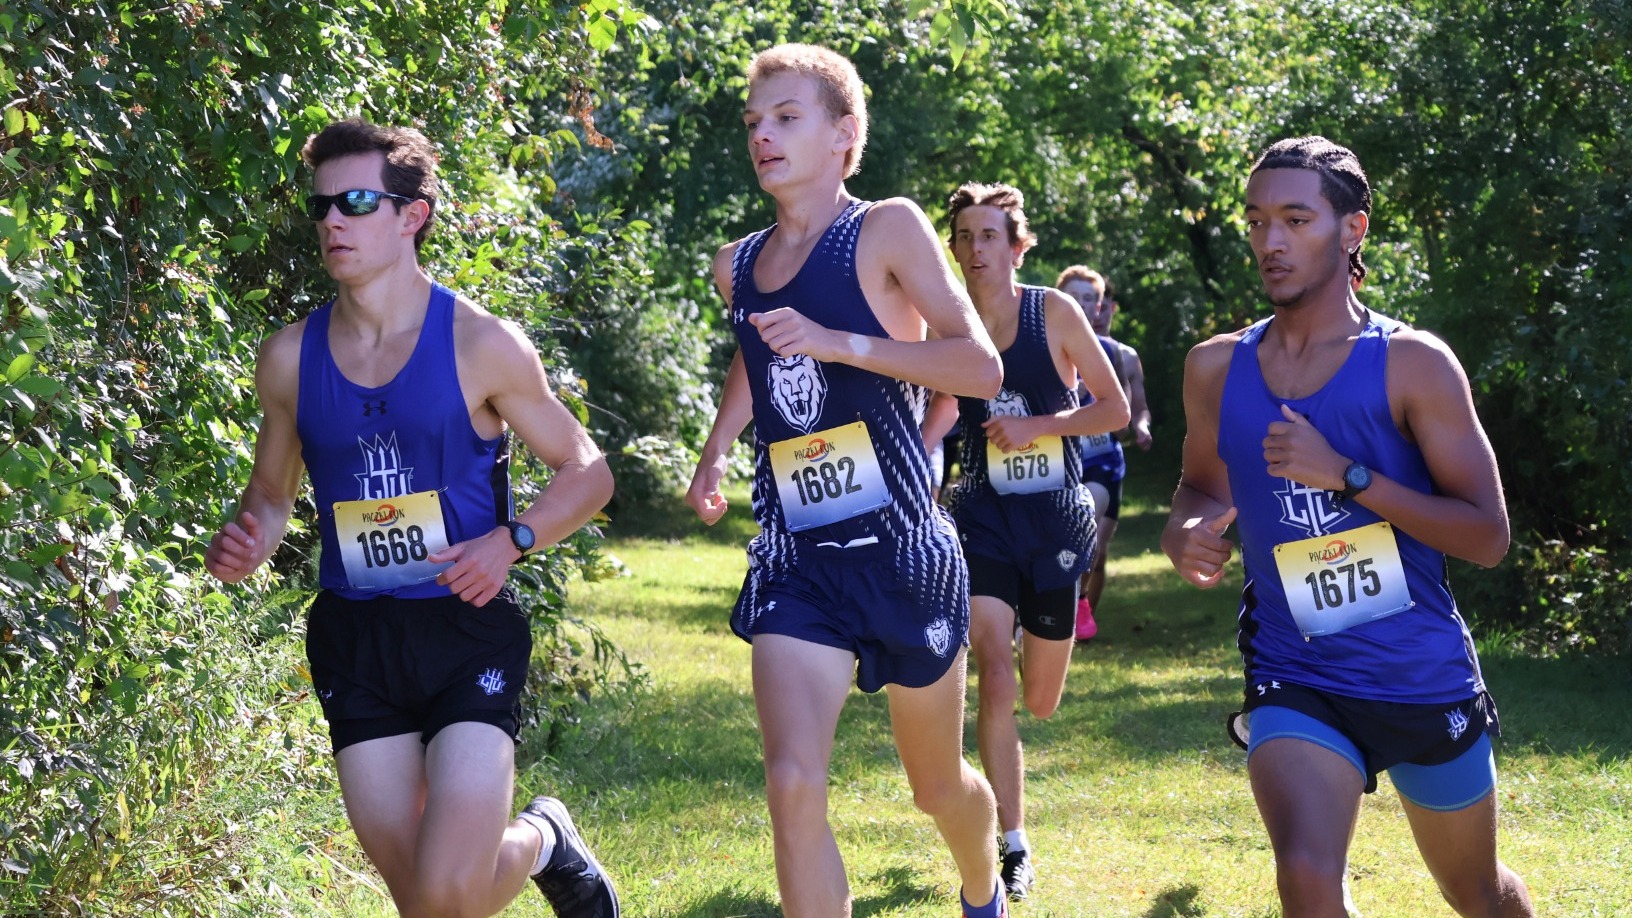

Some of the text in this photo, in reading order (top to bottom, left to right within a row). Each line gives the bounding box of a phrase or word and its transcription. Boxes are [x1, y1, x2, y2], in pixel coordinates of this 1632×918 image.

[791, 456, 863, 506] 1682
[1003, 453, 1050, 481] 1678
[356, 524, 428, 569] 1668
[1305, 557, 1382, 611] 1675
